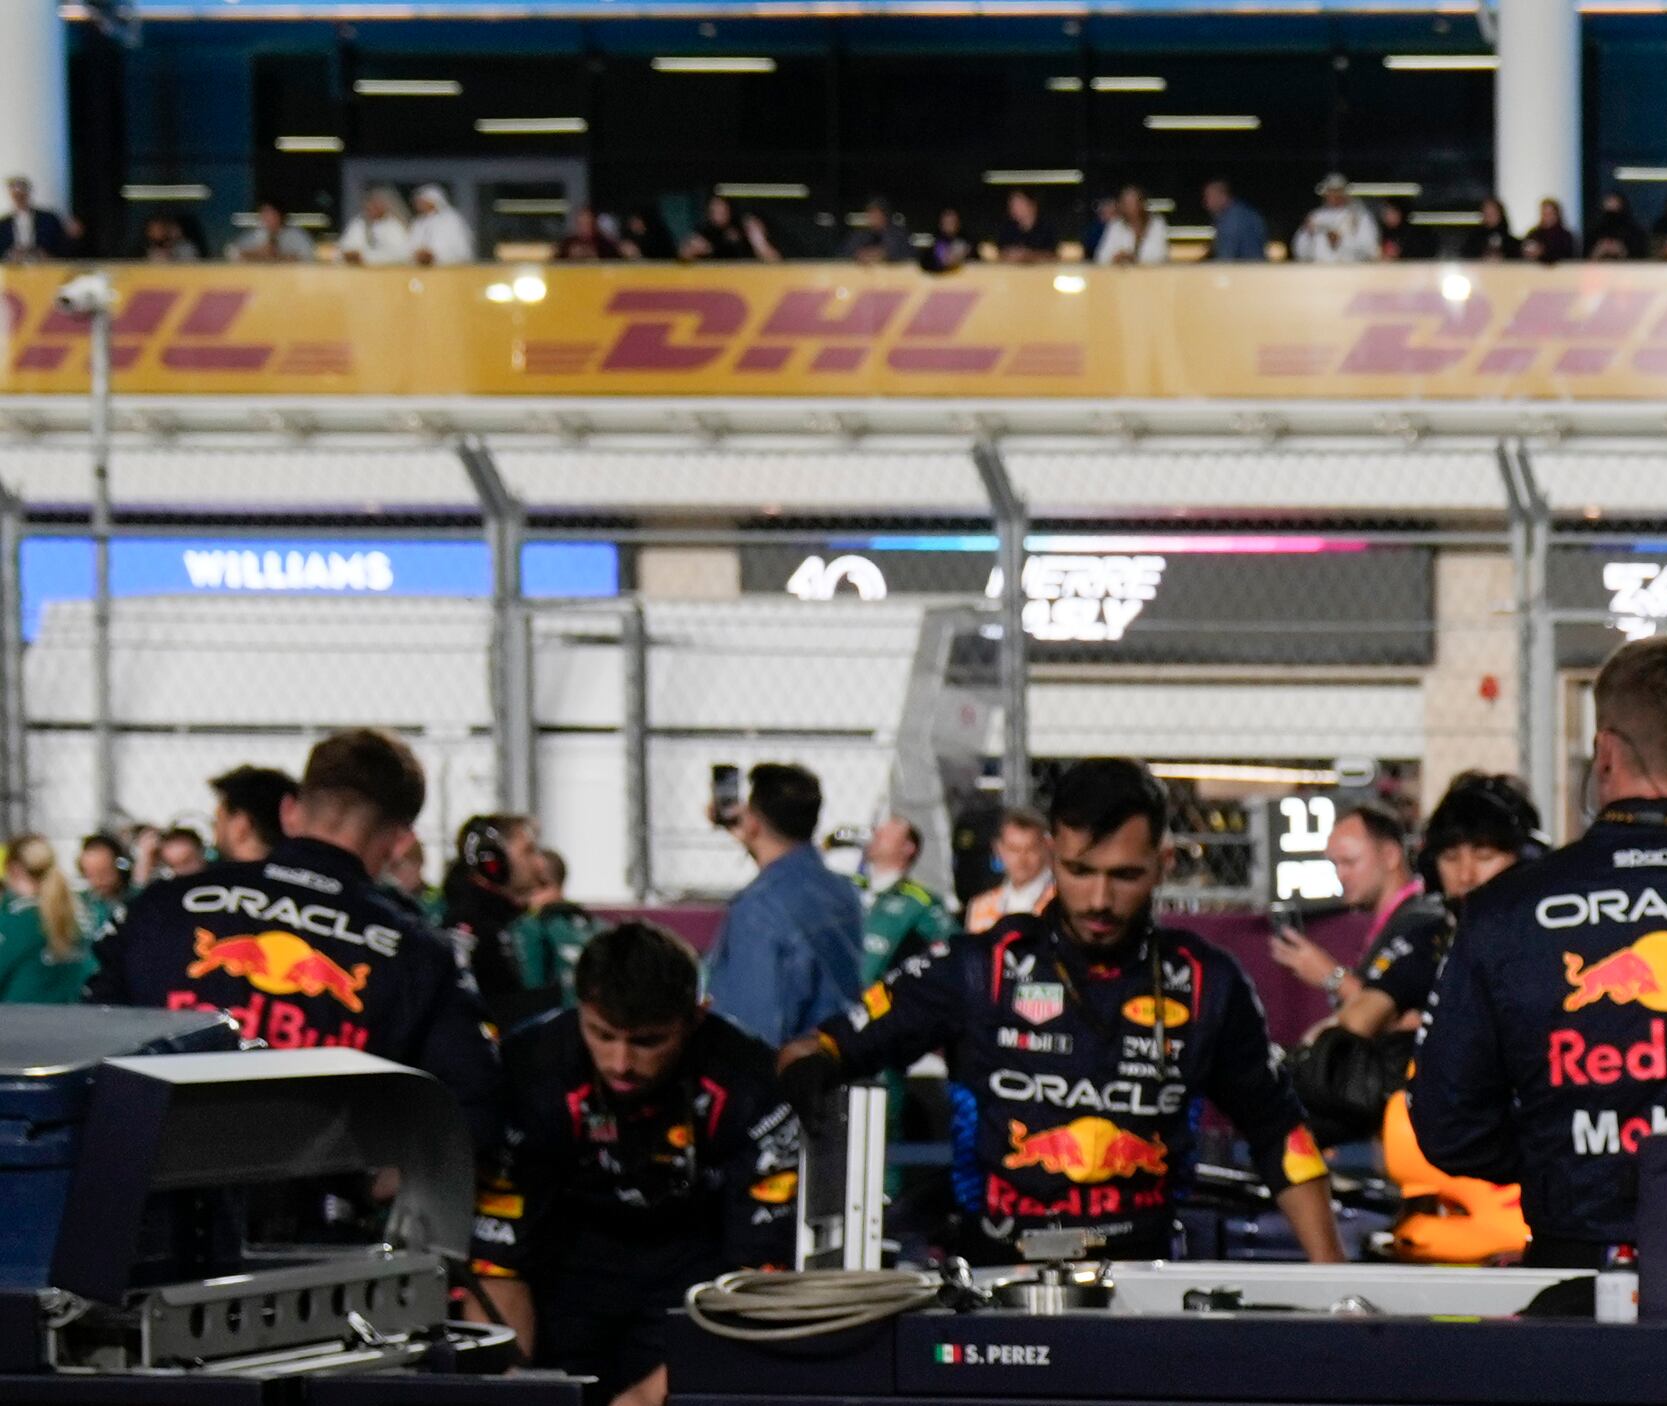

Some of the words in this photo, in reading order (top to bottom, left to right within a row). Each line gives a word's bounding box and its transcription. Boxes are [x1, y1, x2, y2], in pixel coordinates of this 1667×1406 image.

[0, 288, 275, 371] HL
[601, 290, 1005, 372] DHL
[184, 551, 393, 591] WILLIAMS
[182, 885, 400, 957] ORACLE
[167, 991, 266, 1041] Rd
[998, 1026, 1050, 1052] Mobil
[1547, 1018, 1667, 1087] Red
[988, 1068, 1187, 1116] ORACLE
[965, 1344, 985, 1365] S.
[986, 1344, 1051, 1366] PEREZ
